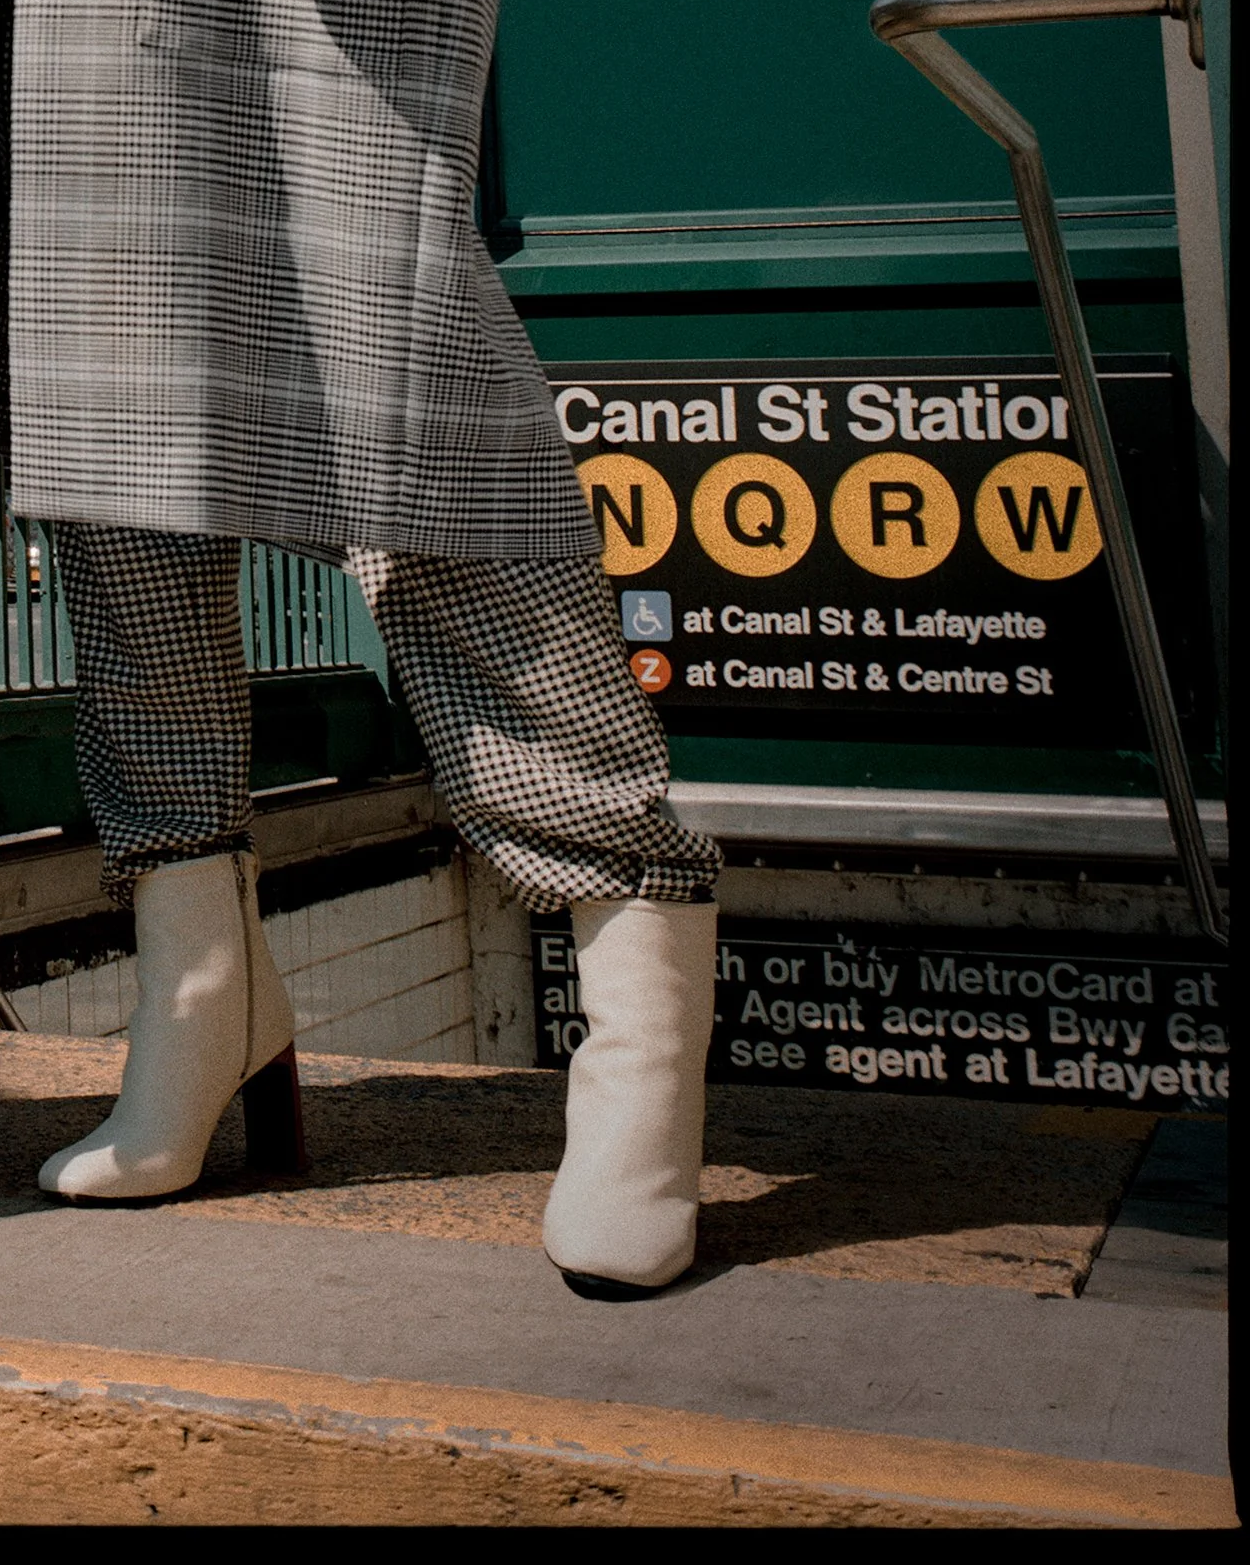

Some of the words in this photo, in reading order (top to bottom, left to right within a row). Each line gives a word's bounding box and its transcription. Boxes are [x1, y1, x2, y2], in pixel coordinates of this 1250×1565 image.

[554, 386, 738, 444] Canal
[757, 384, 831, 443] St
[591, 483, 645, 547] N
[723, 480, 787, 552] Q
[868, 481, 928, 547] R
[997, 486, 1083, 553] W
[683, 606, 715, 634] at
[720, 605, 811, 635] Canal
[818, 606, 855, 636] St
[861, 607, 888, 637] &
[895, 607, 1047, 645] Lafayette
[639, 656, 662, 684] Z
[685, 660, 717, 688] at
[723, 659, 814, 689] Canal
[821, 661, 858, 691] St
[864, 662, 890, 691] &
[897, 662, 1008, 694] Centre
[1016, 664, 1054, 695] St
[763, 956, 807, 985] or
[823, 950, 899, 998] buy
[920, 956, 1154, 1004] MetroCard
[1173, 971, 1221, 1008] at
[740, 989, 867, 1036] Agent
[881, 1006, 1031, 1044] across
[1049, 1006, 1147, 1057] Bwy
[729, 1038, 807, 1071] see
[825, 1042, 950, 1085] agent
[964, 1047, 1011, 1085] at
